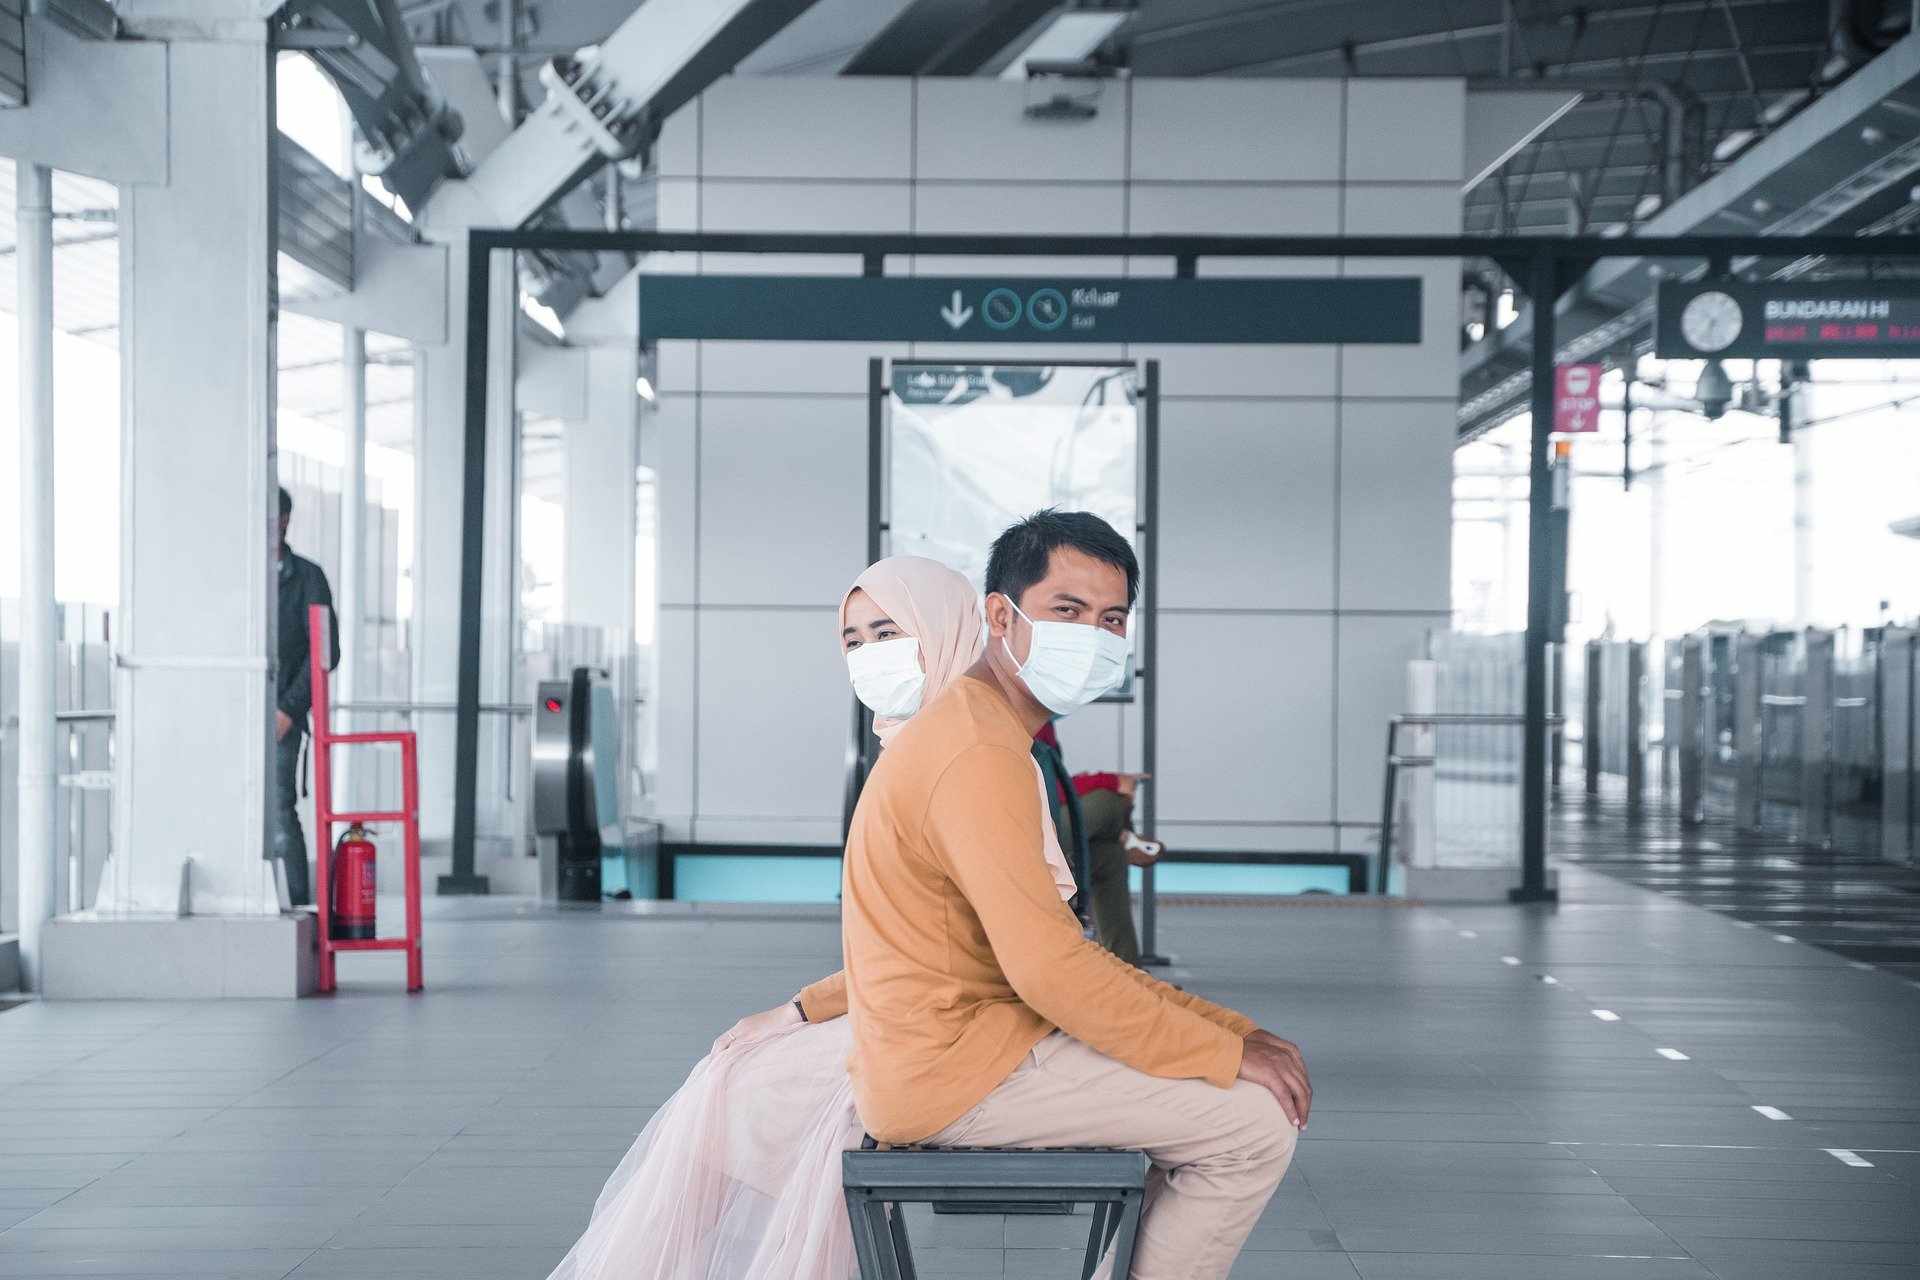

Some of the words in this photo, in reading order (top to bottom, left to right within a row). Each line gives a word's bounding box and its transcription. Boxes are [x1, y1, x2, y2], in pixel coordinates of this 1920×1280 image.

[1765, 300, 1867, 319] BUNDARAN
[1870, 300, 1889, 319] HI
[1560, 398, 1596, 412] STOP
